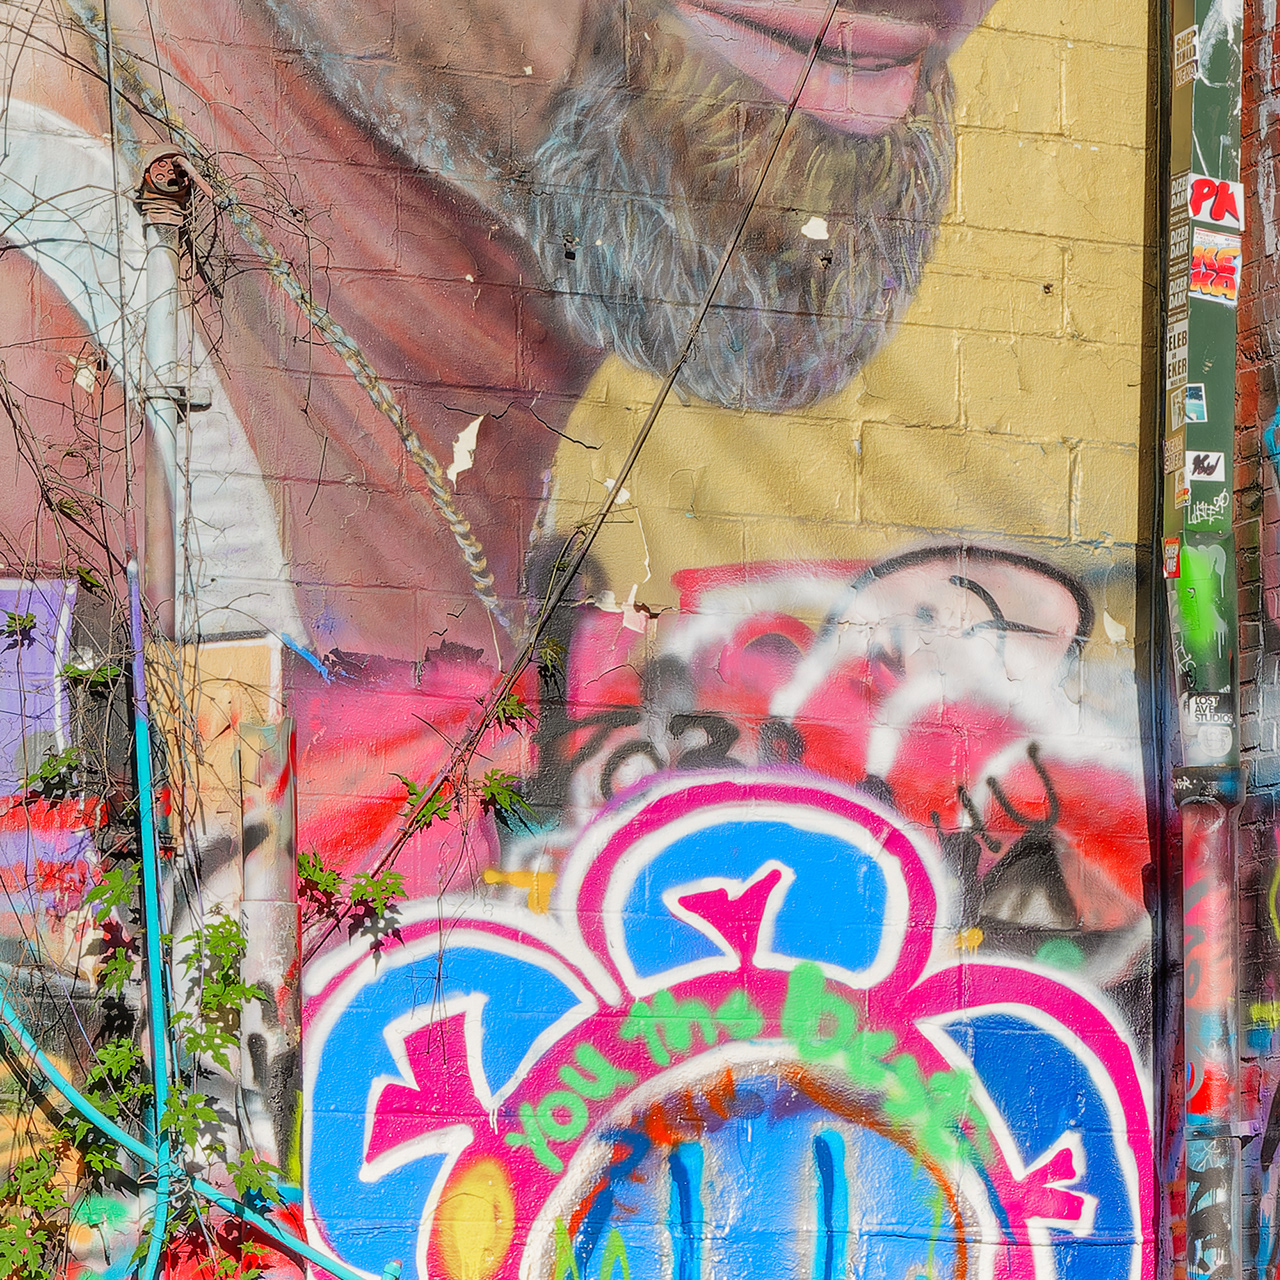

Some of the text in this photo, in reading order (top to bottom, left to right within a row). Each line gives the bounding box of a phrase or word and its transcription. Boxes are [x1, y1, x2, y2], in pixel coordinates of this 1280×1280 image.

[1170, 226, 1189, 245] DIZER
[1170, 240, 1188, 259] DARK
[1169, 276, 1187, 295] DIZER
[1168, 291, 1186, 309] DARK
[1195, 696, 1219, 705] LOST
[1195, 705, 1214, 714] AVE
[1195, 713, 1233, 723] STUDIOS
